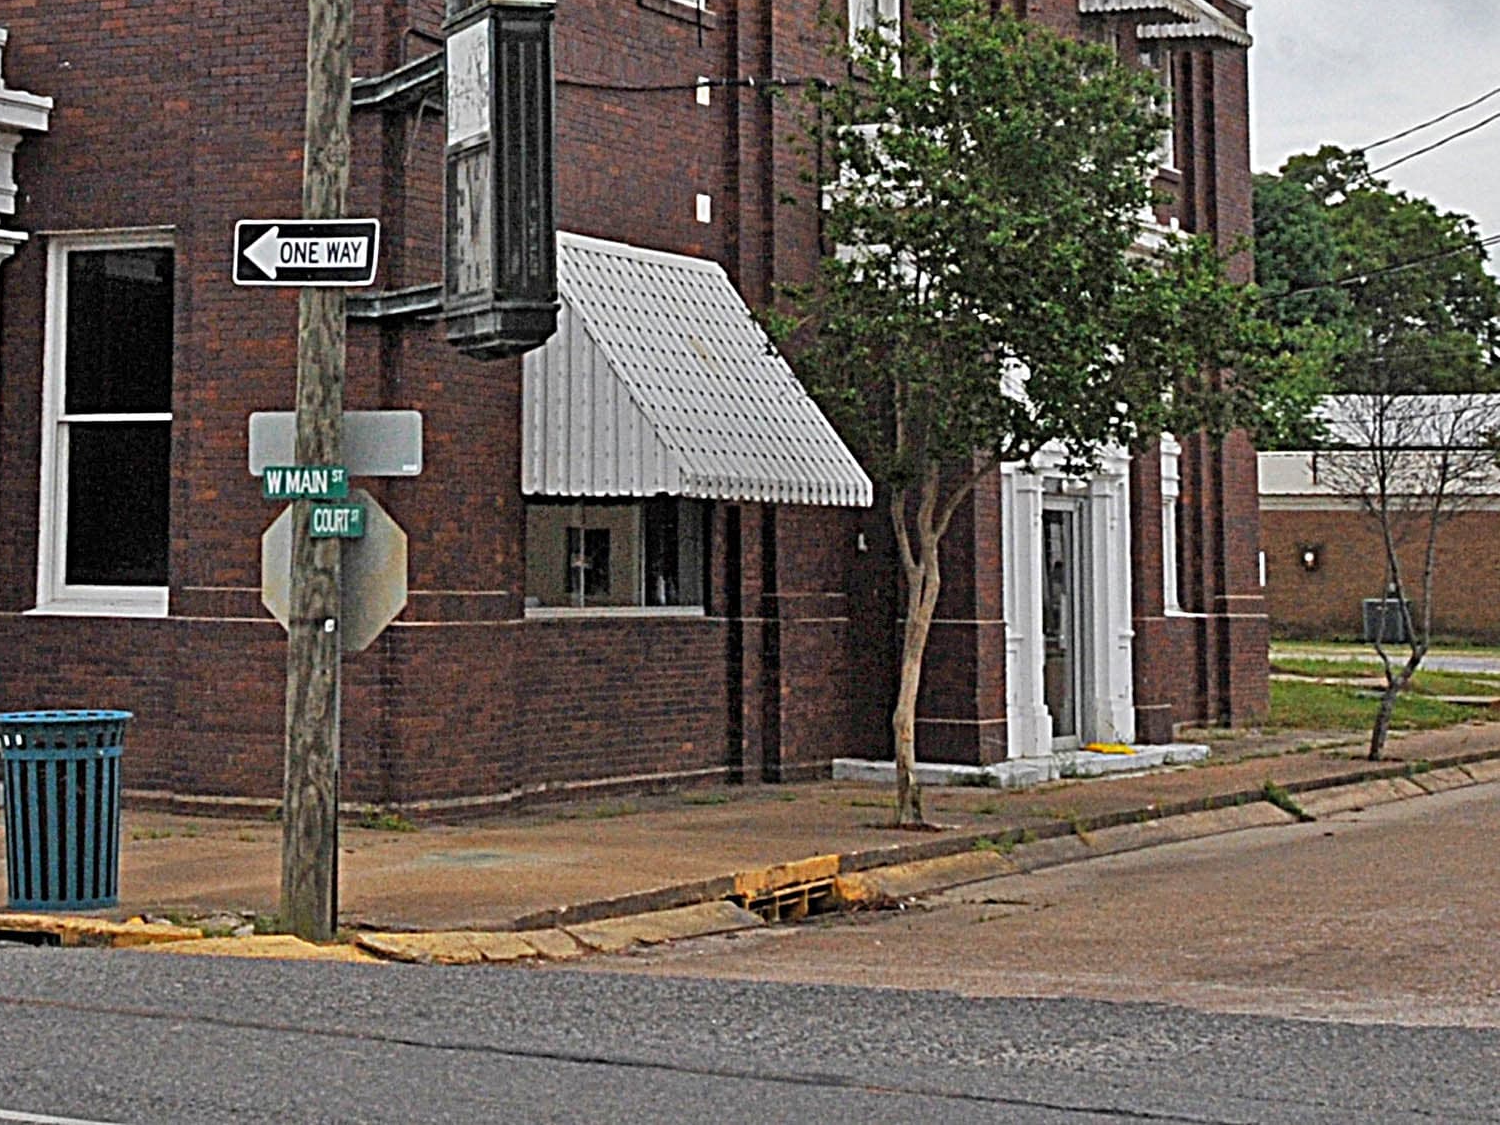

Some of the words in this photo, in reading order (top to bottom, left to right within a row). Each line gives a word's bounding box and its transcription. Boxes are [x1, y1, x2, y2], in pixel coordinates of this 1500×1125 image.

[280, 241, 319, 264] ONE
[326, 241, 362, 264] WAY
[266, 469, 283, 495] W
[285, 469, 328, 495] MAIN
[331, 470, 344, 483] ST
[313, 508, 349, 533] COURT
[351, 509, 360, 522] ST
